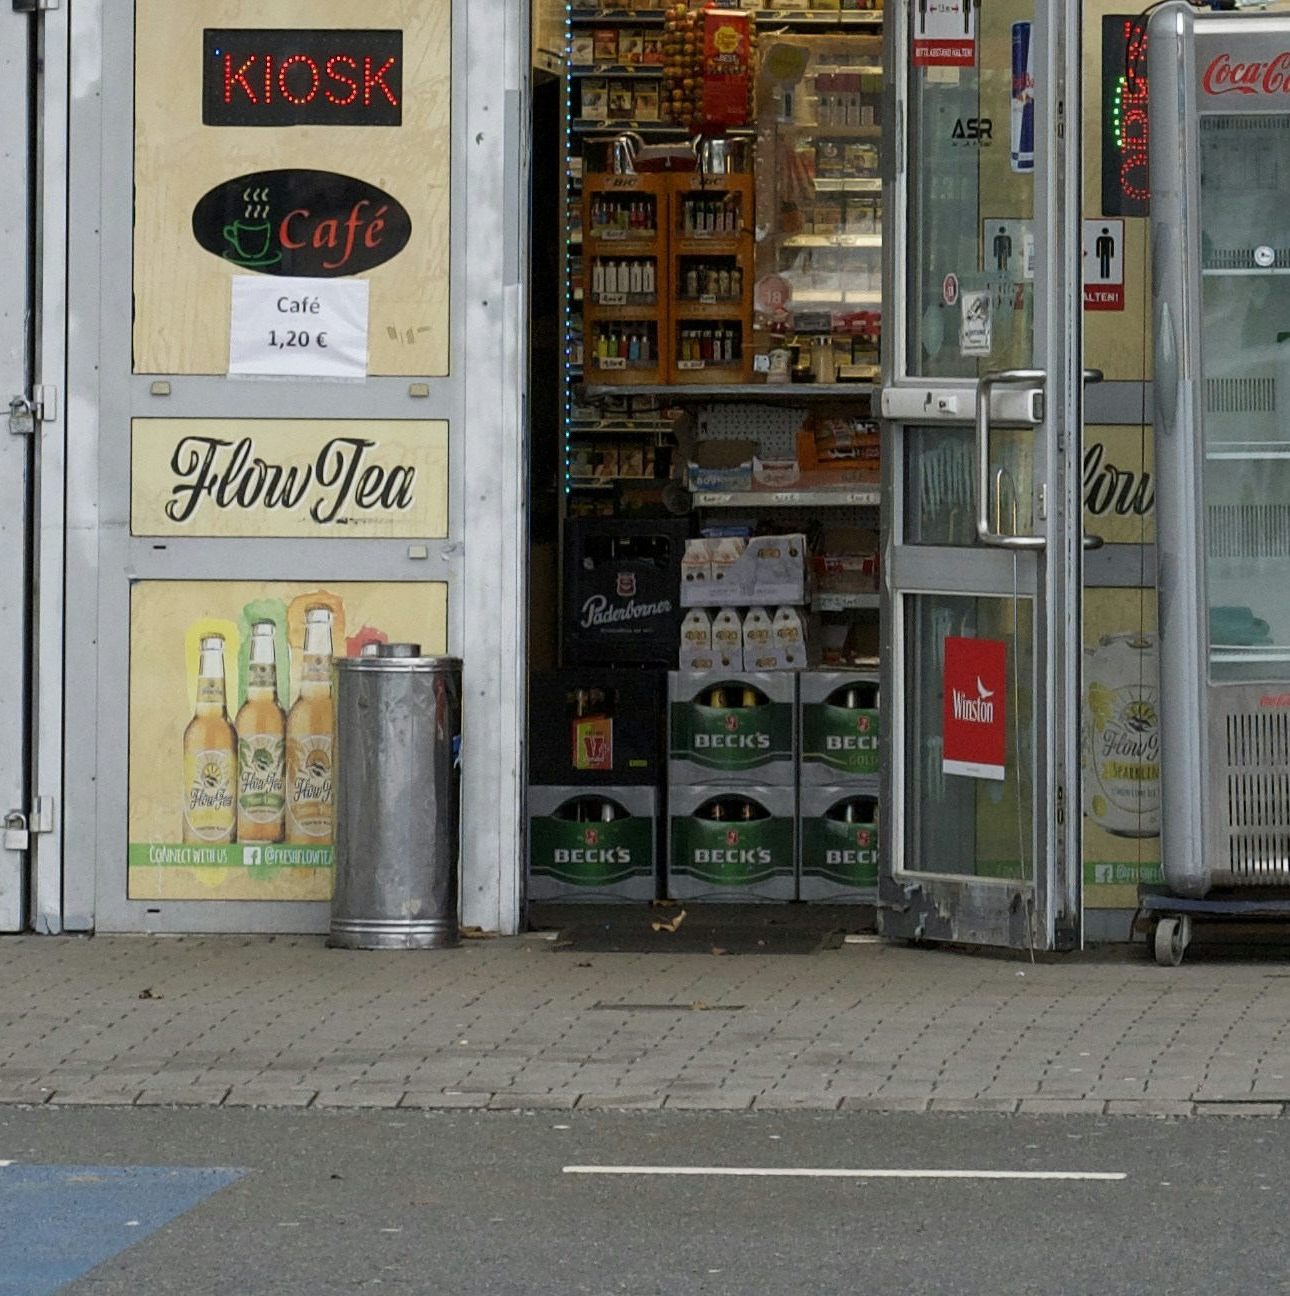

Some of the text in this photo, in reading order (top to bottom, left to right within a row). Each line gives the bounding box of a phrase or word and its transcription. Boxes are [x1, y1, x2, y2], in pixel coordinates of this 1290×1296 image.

[223, 54, 398, 106] KIOSK
[951, 118, 993, 139] ASR
[278, 199, 389, 268] Café
[276, 296, 321, 314] Café
[267, 330, 328, 350] 1,20 €
[580, 594, 672, 628] Paderborner
[952, 687, 994, 724] Winston
[693, 731, 771, 750] BECK'S
[553, 846, 631, 864] BECK'S
[694, 846, 772, 864] BECK'S
